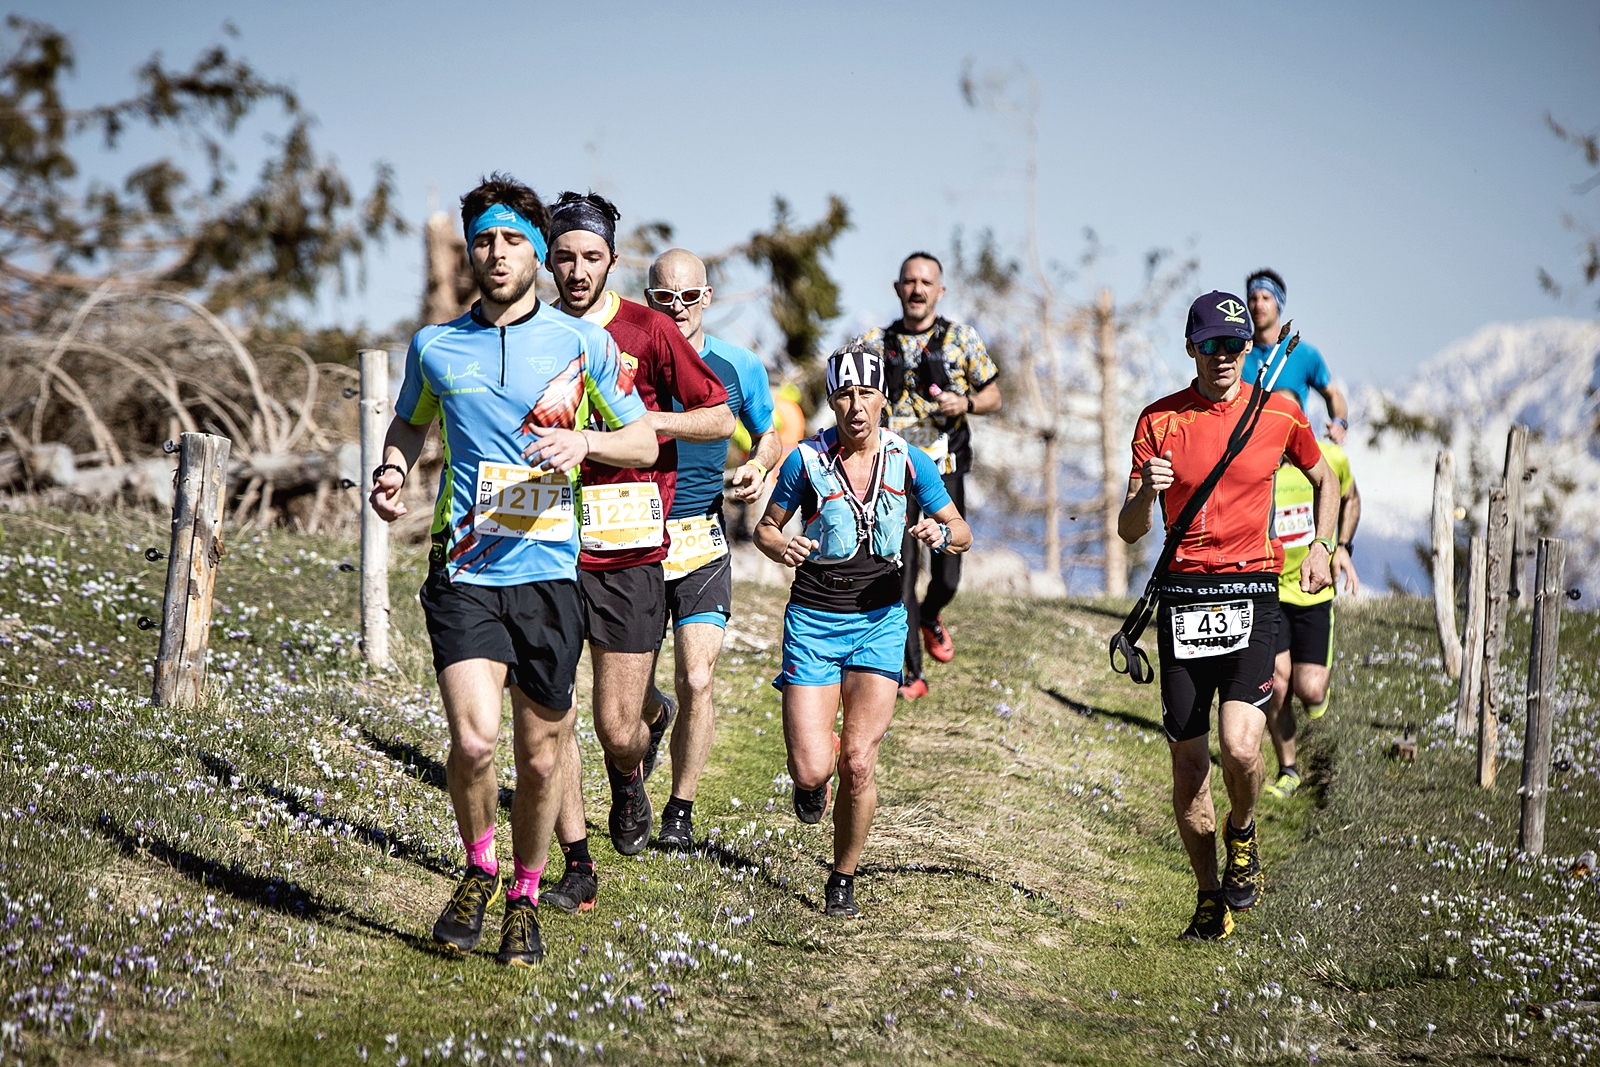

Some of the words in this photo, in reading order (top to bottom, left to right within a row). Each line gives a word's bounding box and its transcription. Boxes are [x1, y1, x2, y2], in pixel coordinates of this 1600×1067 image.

[496, 485, 560, 511] 1217
[593, 502, 651, 525] 1222
[1198, 612, 1229, 636] 43
